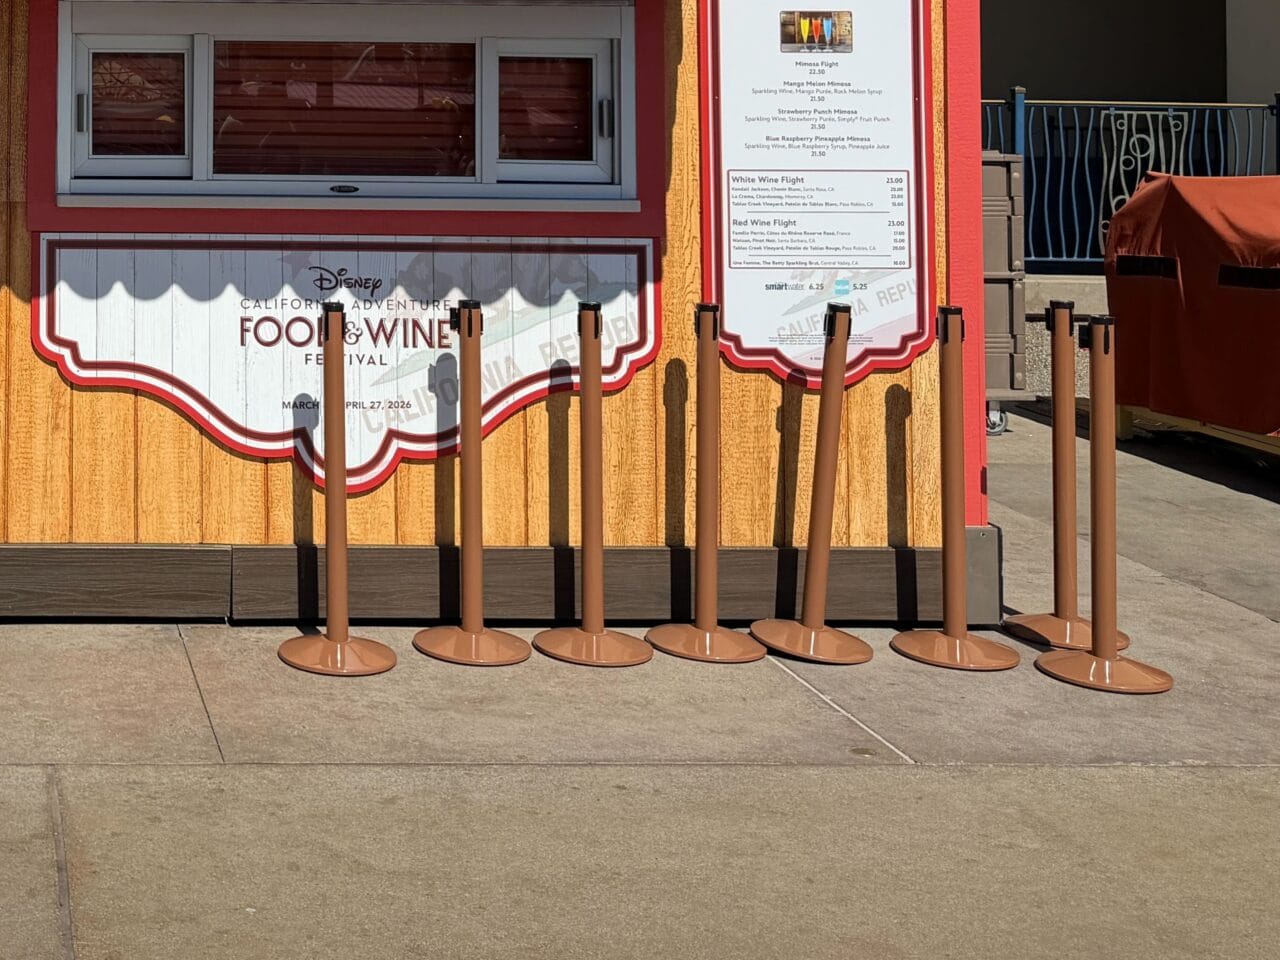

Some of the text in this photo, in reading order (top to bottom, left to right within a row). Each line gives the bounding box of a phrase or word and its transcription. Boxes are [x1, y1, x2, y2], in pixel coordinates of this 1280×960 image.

[777, 108, 812, 116] Strawberry
[781, 176, 804, 185] Flight
[773, 219, 797, 228] Flight
[308, 266, 382, 297] Disney
[352, 300, 451, 311] ADVENTURE
[240, 316, 452, 349] FOO & WINE
[305, 353, 388, 366] FEIVAL
[282, 401, 320, 410] MARCH
[345, 400, 412, 411] PRIL 27, 2026
